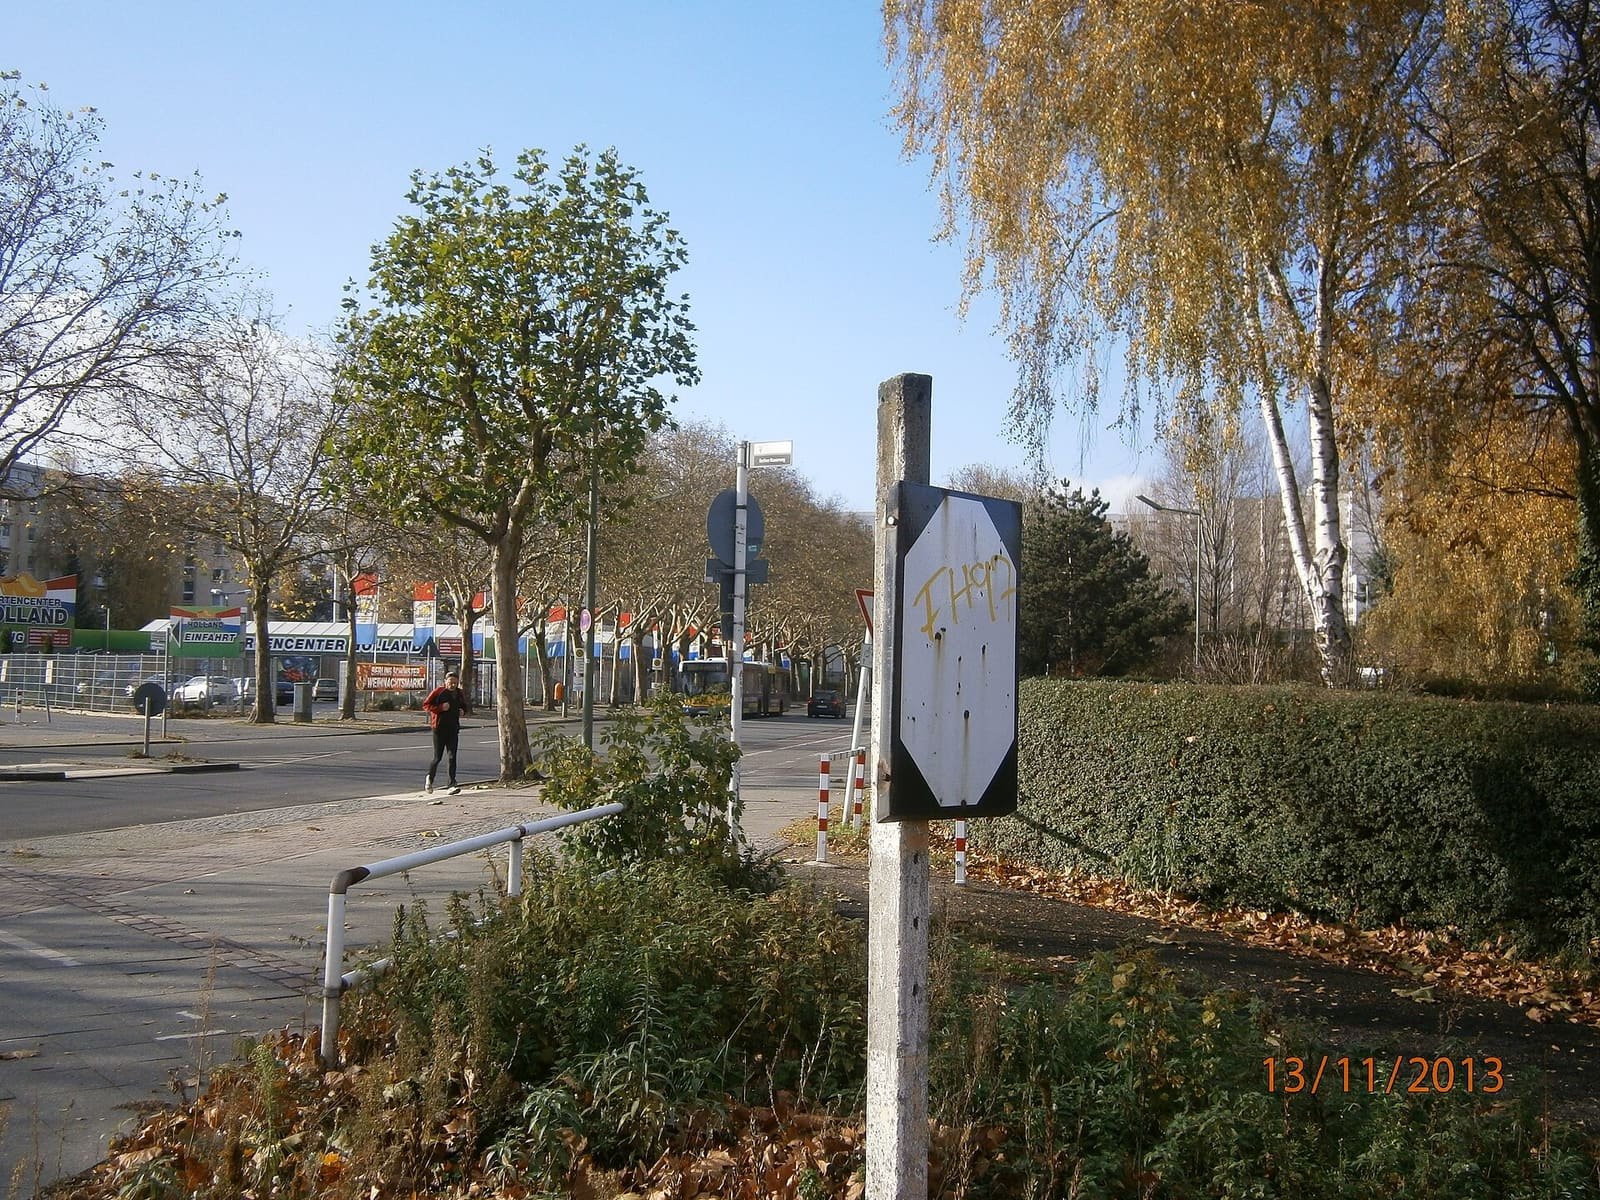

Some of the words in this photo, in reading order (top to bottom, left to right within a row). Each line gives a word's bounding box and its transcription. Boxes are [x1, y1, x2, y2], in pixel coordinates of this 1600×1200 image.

[187, 621, 224, 629] HOLLAND
[184, 633, 236, 642] EINFAHRT
[367, 677, 425, 688] WEIHNACHTSMARKT
